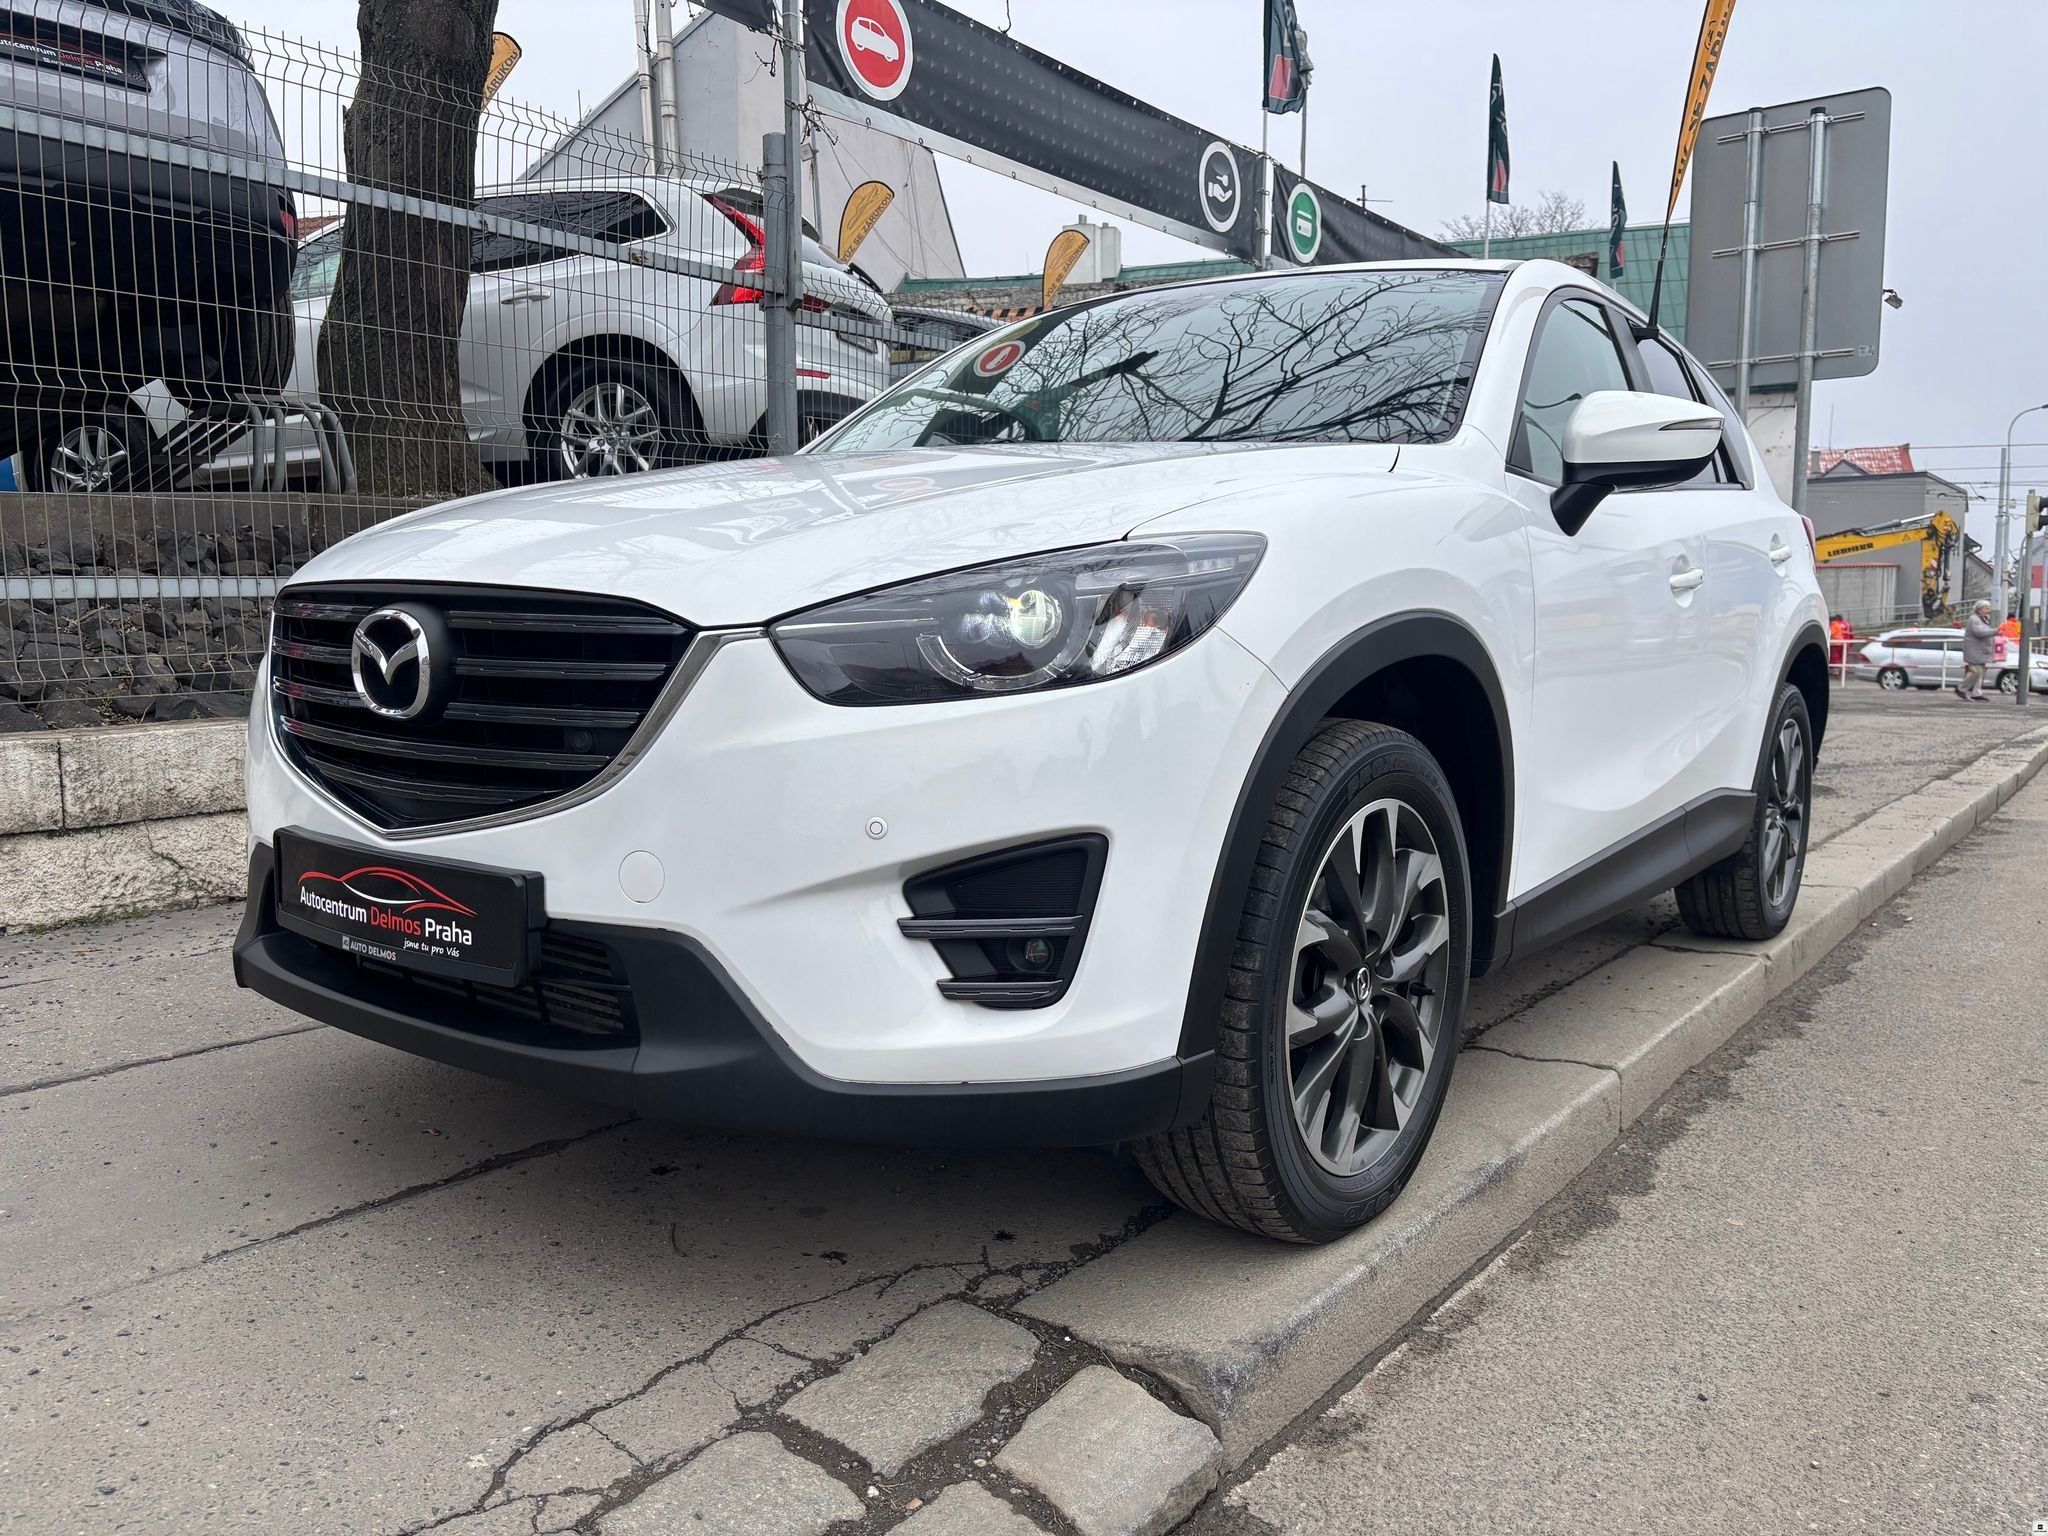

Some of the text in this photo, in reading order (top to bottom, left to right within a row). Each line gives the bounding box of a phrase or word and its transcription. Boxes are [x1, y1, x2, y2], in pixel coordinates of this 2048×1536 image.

[853, 232, 864, 245] SE
[300, 885, 473, 946] Autocentrum Delmos Praha
[350, 940, 397, 961] AUTO DELMOS
[402, 937, 460, 958] jsme tu pro Vás
